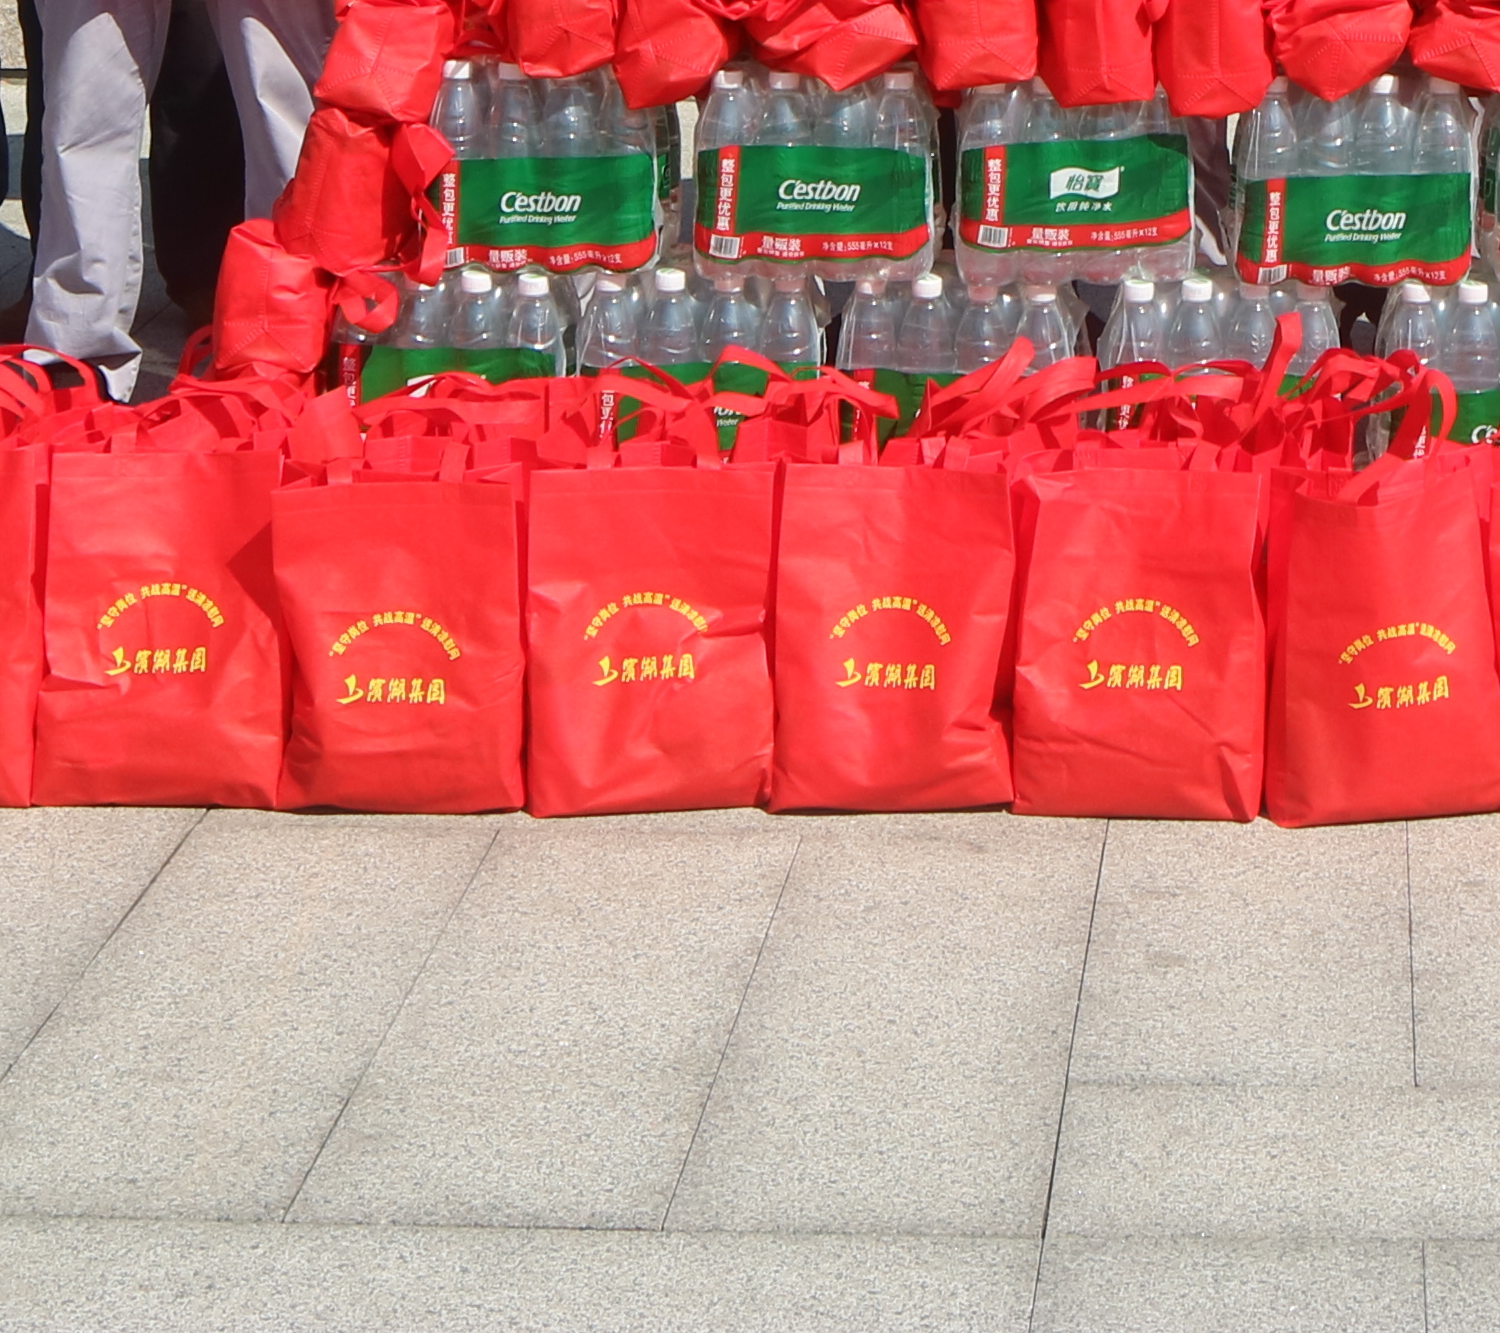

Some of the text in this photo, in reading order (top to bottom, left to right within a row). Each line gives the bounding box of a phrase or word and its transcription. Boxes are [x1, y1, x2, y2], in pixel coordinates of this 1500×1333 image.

[716, 159, 735, 231] 整包更优惠
[985, 159, 1002, 221] 整包更优惠
[1265, 192, 1281, 263] 整包更优惠
